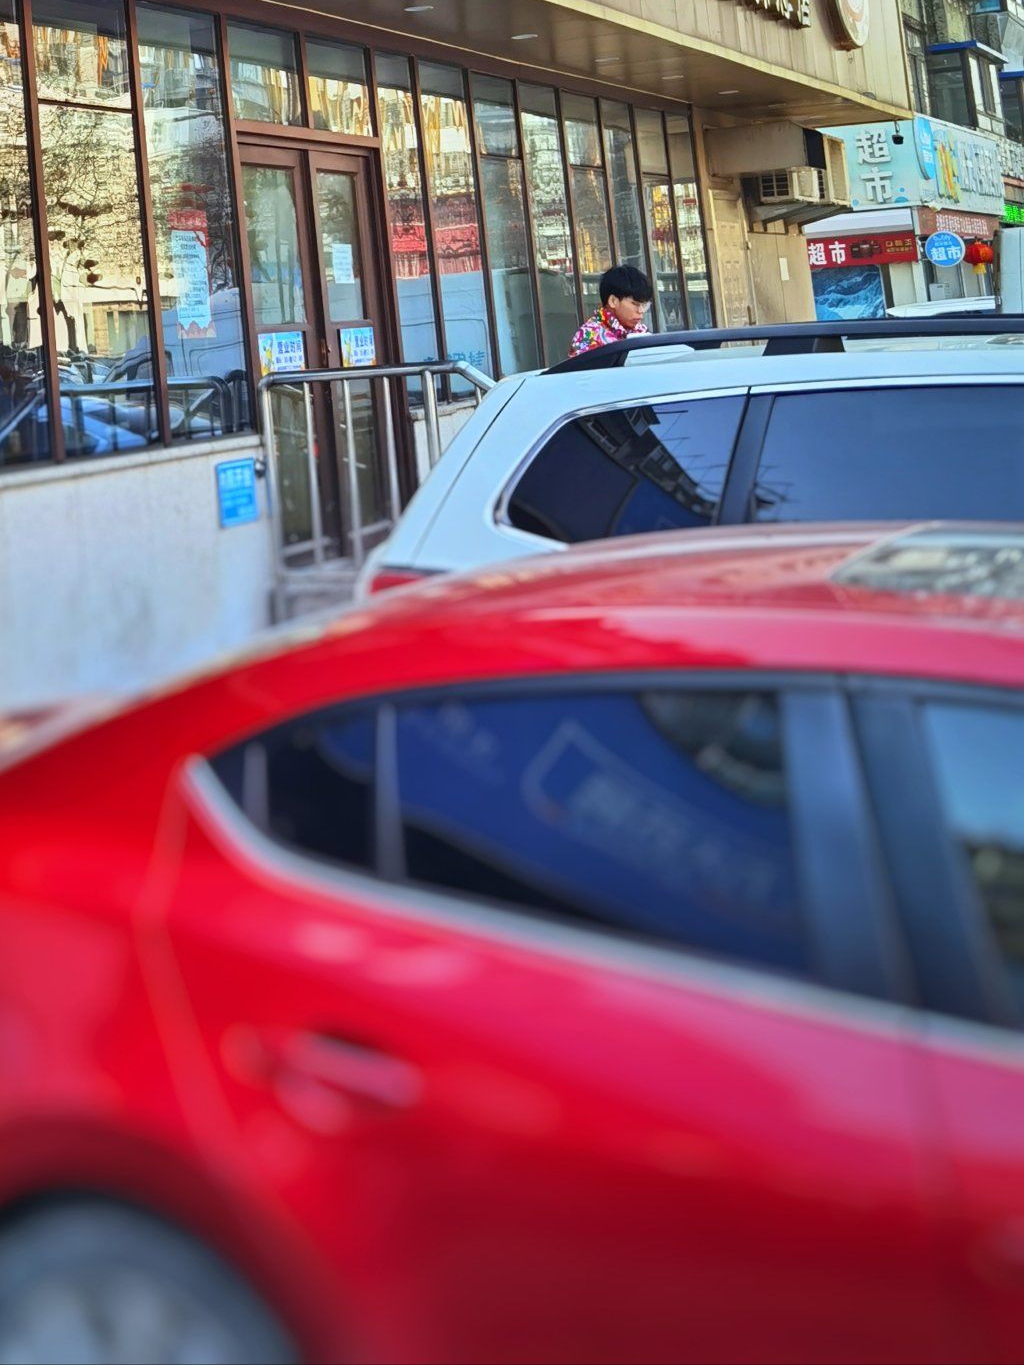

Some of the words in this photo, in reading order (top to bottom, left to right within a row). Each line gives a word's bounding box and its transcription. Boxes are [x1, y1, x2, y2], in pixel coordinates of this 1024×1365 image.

[856, 129, 893, 204] 超市
[807, 240, 846, 266] 超市
[930, 245, 962, 262] 超市
